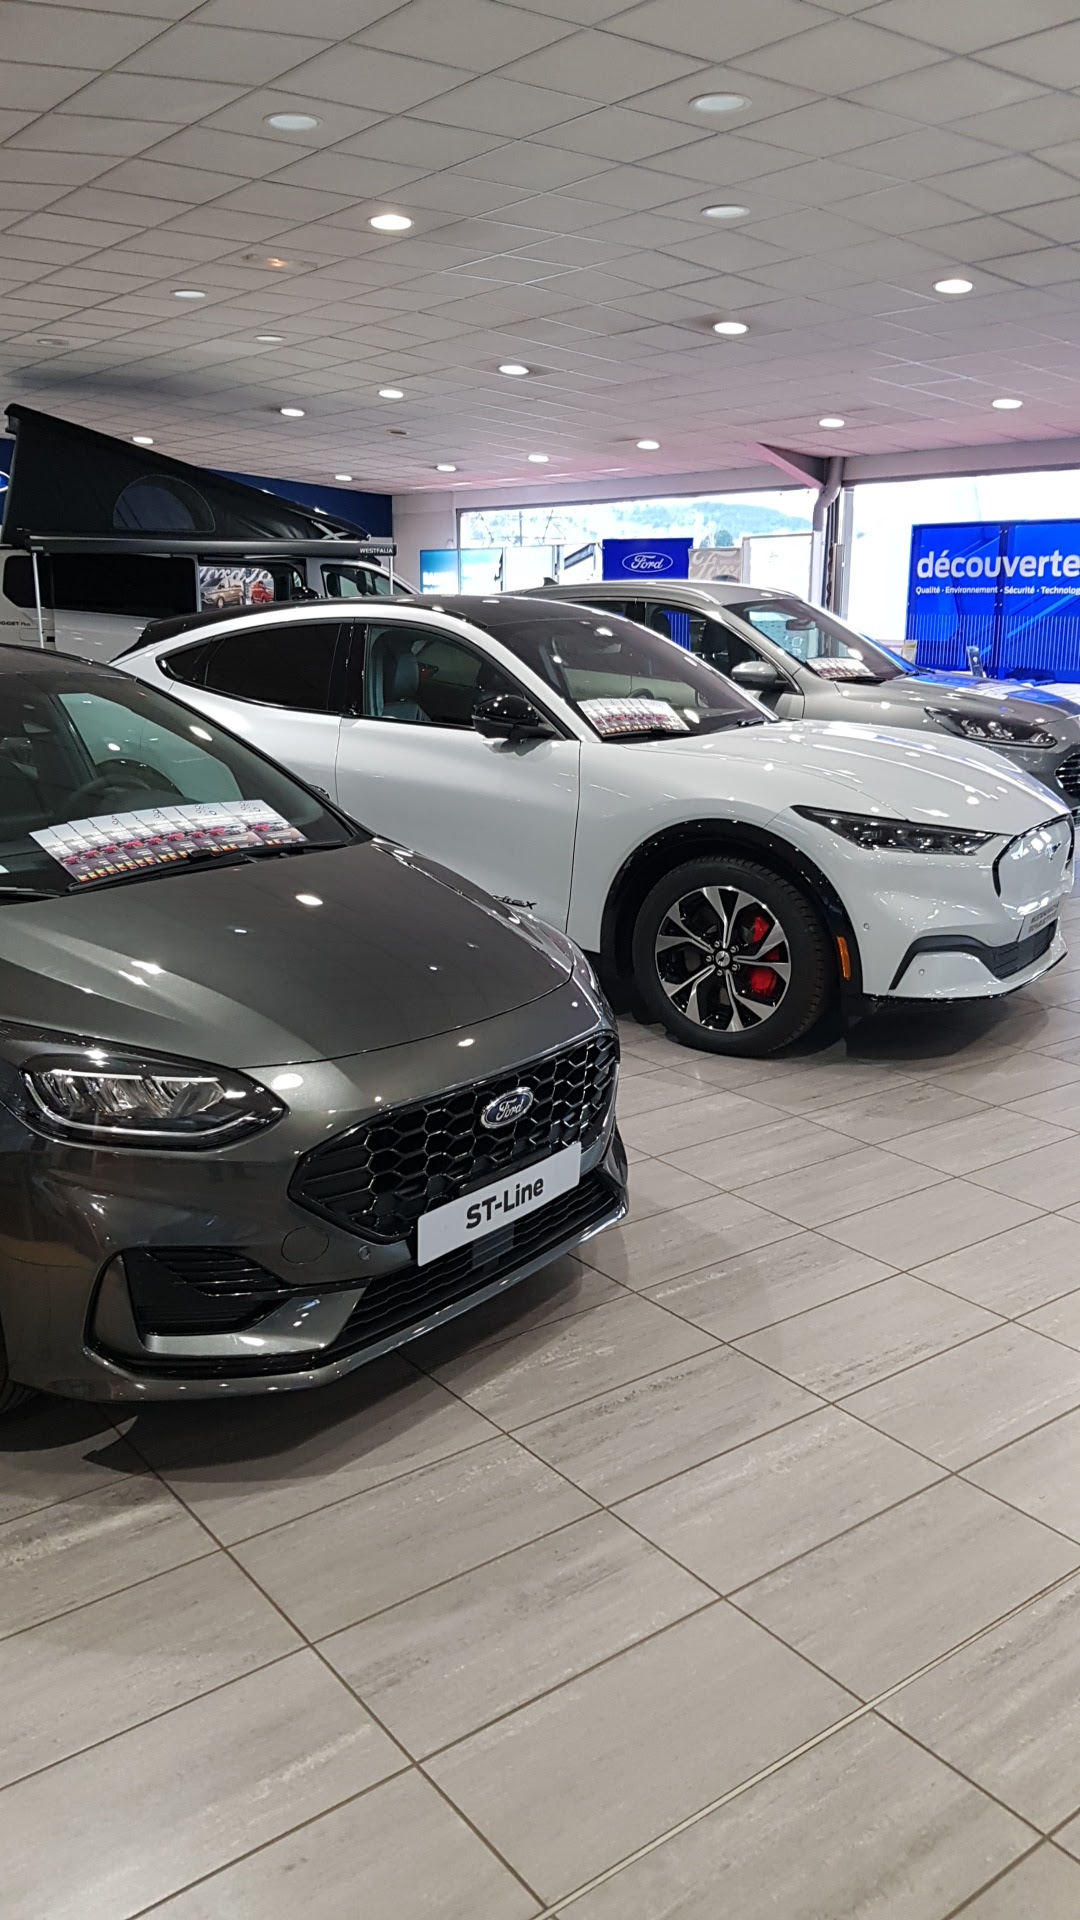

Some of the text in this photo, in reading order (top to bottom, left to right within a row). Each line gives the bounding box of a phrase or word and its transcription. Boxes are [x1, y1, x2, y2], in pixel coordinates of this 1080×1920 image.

[632, 555, 663, 569] Ford
[917, 549, 1080, 579] découverte
[915, 586, 941, 596] Qualité
[945, 586, 998, 595] Environnement
[1003, 586, 1036, 595] Sécurité
[496, 1098, 524, 1121] Ford
[466, 1178, 544, 1229] ST-Line
